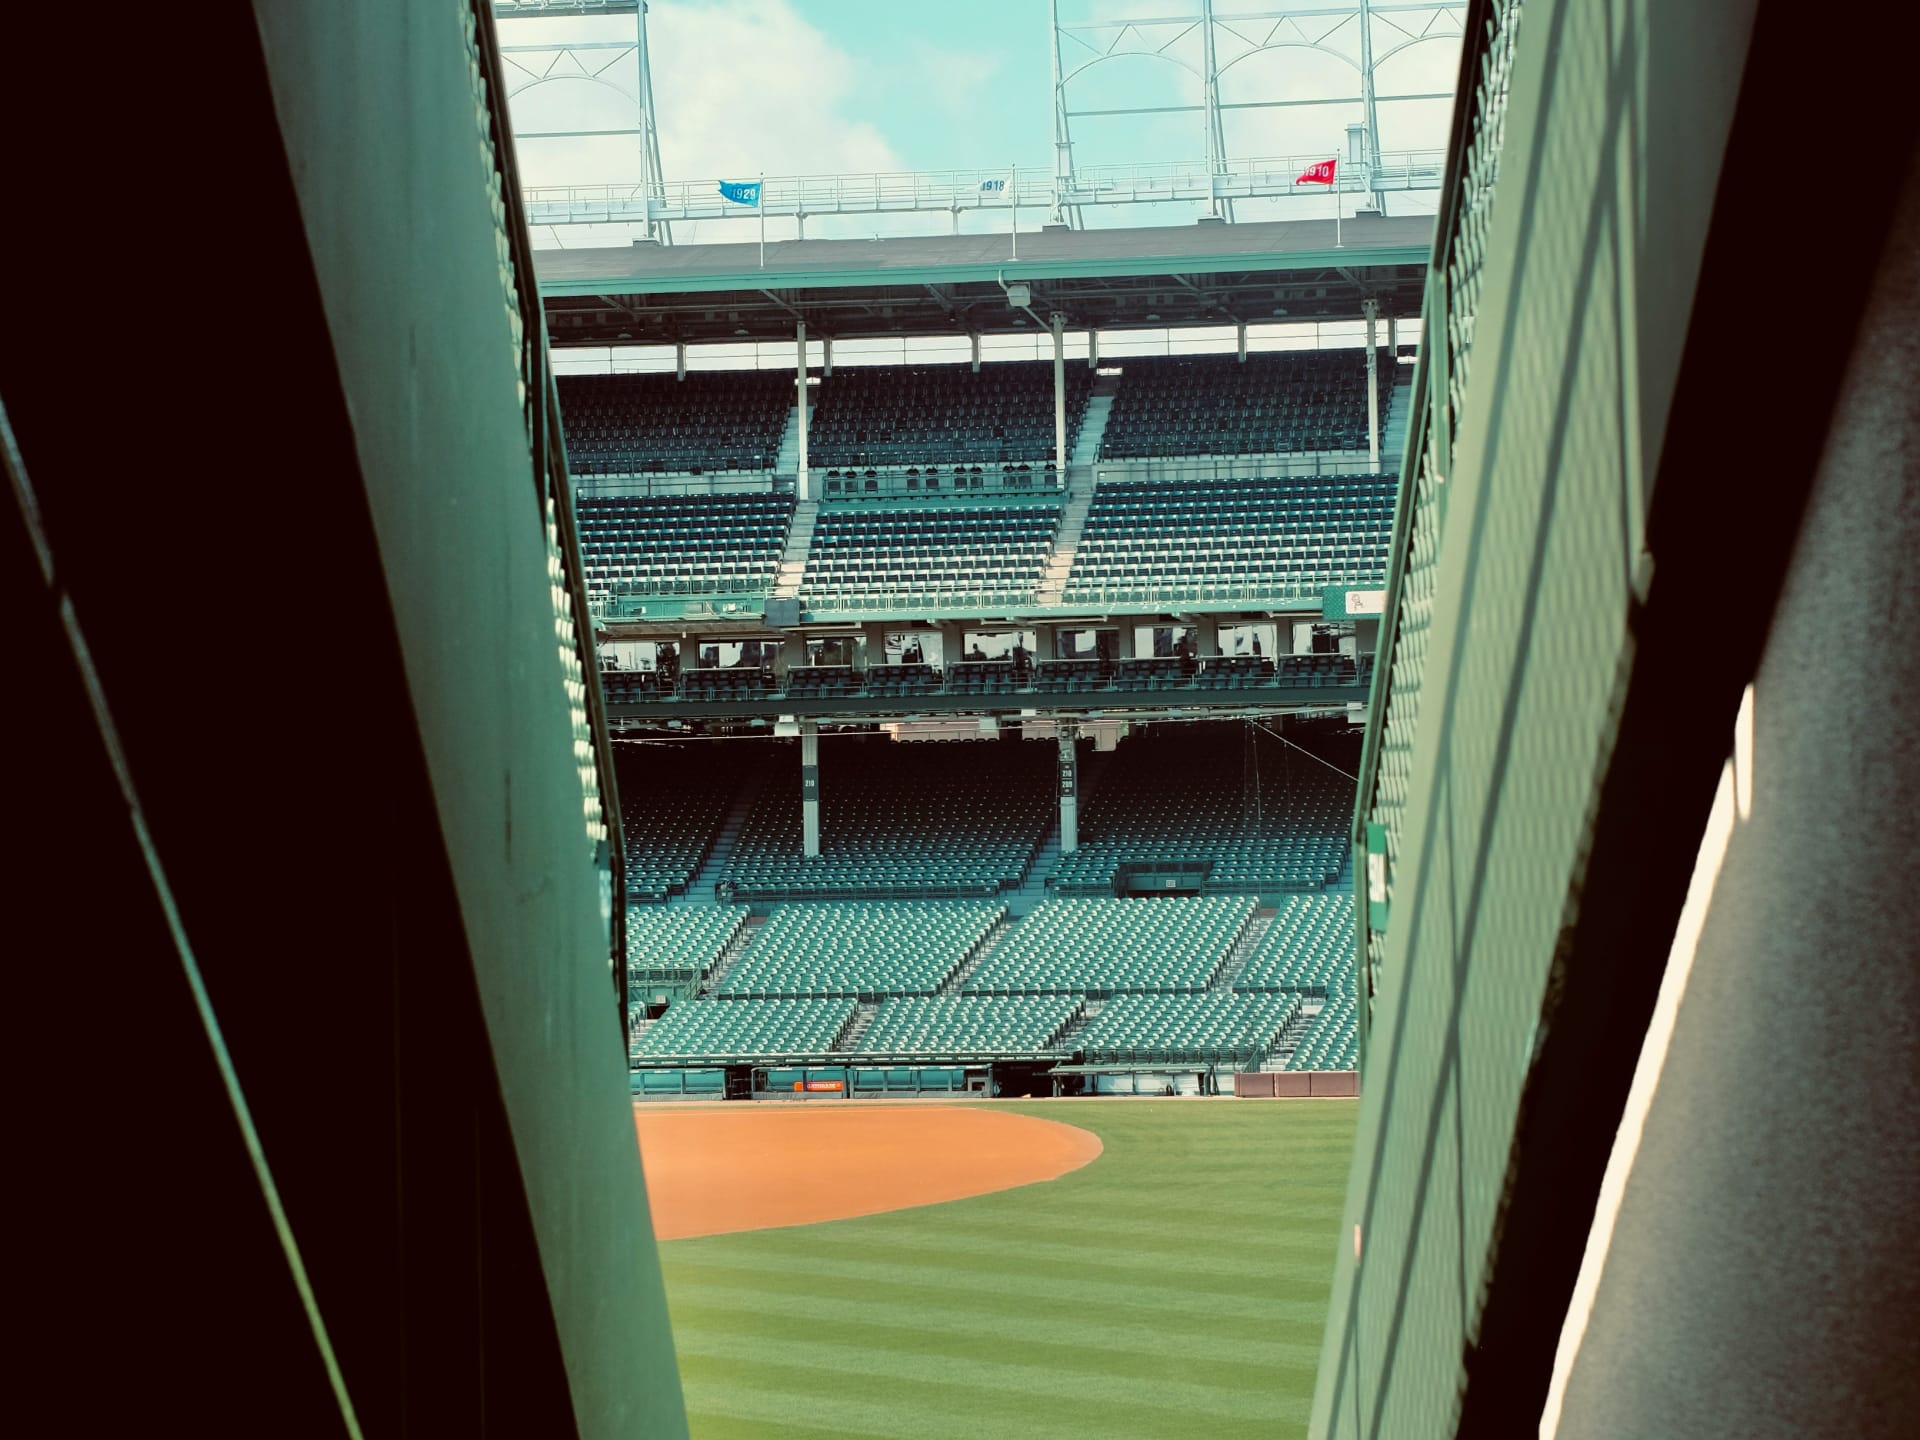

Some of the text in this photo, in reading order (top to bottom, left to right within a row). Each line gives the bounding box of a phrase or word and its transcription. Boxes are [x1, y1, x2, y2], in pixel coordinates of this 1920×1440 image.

[1304, 165, 1329, 177] 1910
[982, 180, 1005, 191] 1918
[732, 187, 756, 200] 1929
